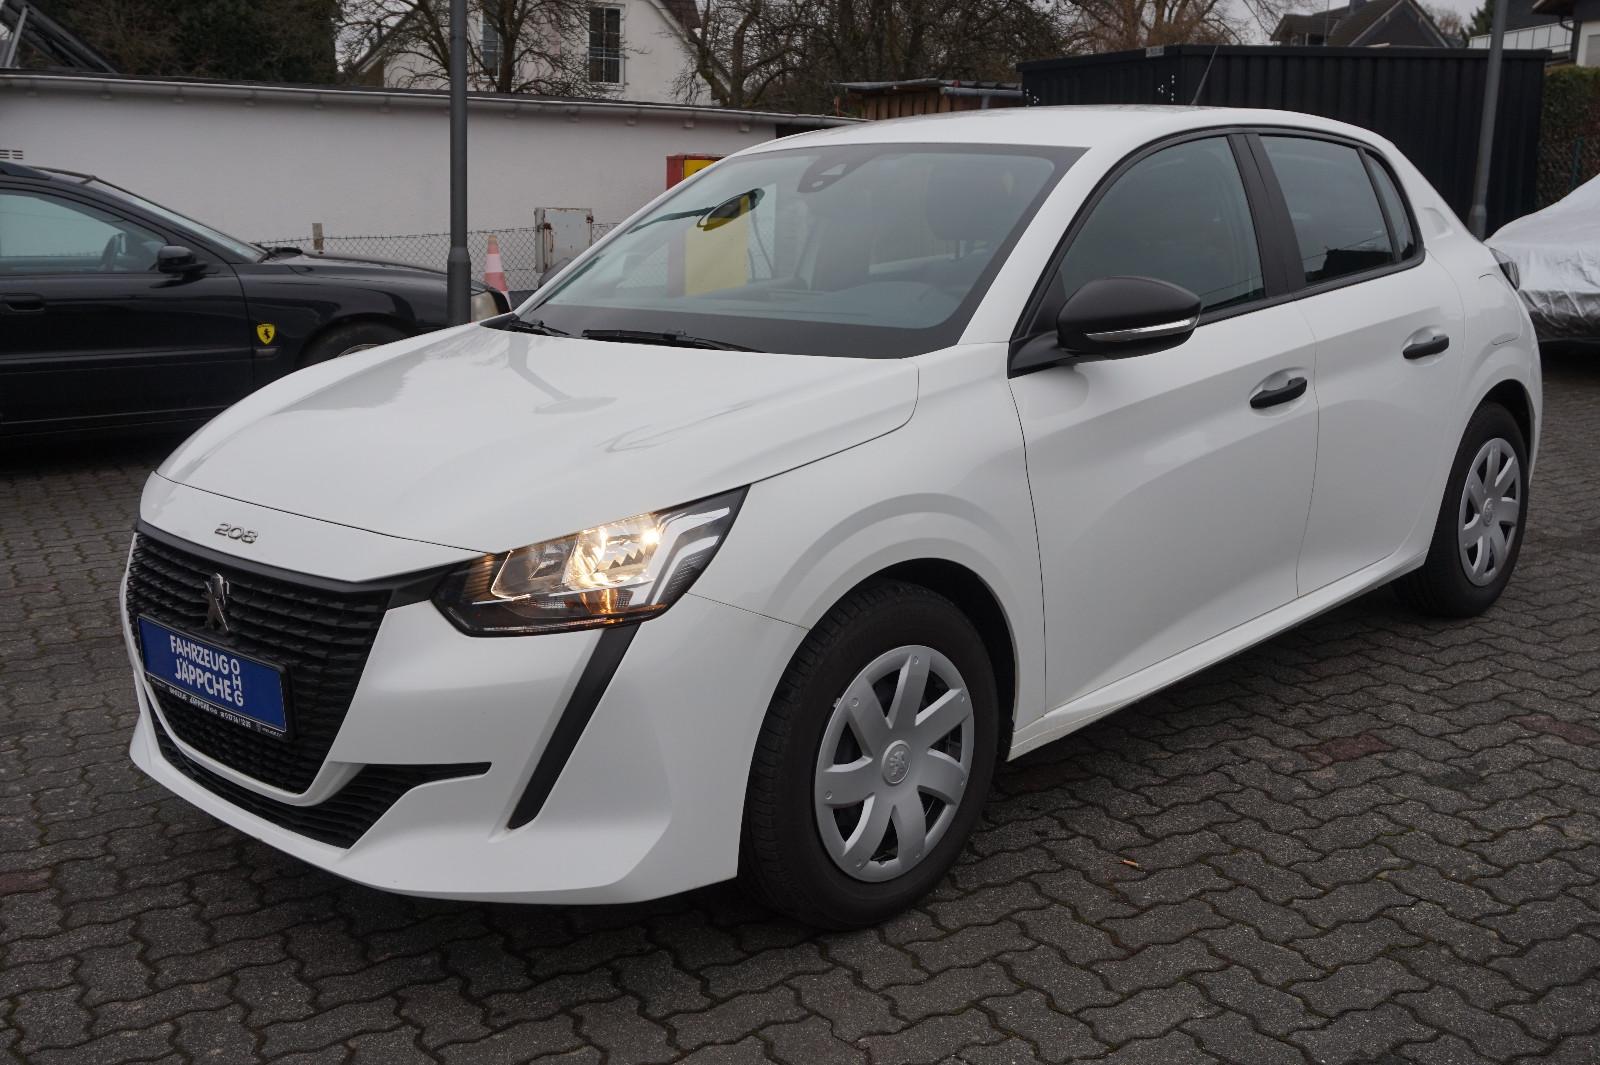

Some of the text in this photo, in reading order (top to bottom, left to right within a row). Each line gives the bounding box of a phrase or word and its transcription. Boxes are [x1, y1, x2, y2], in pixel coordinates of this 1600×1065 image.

[214, 523, 259, 544] 208
[169, 634, 230, 675] FAHRZEUG
[174, 658, 233, 702] JÄPPCHE
